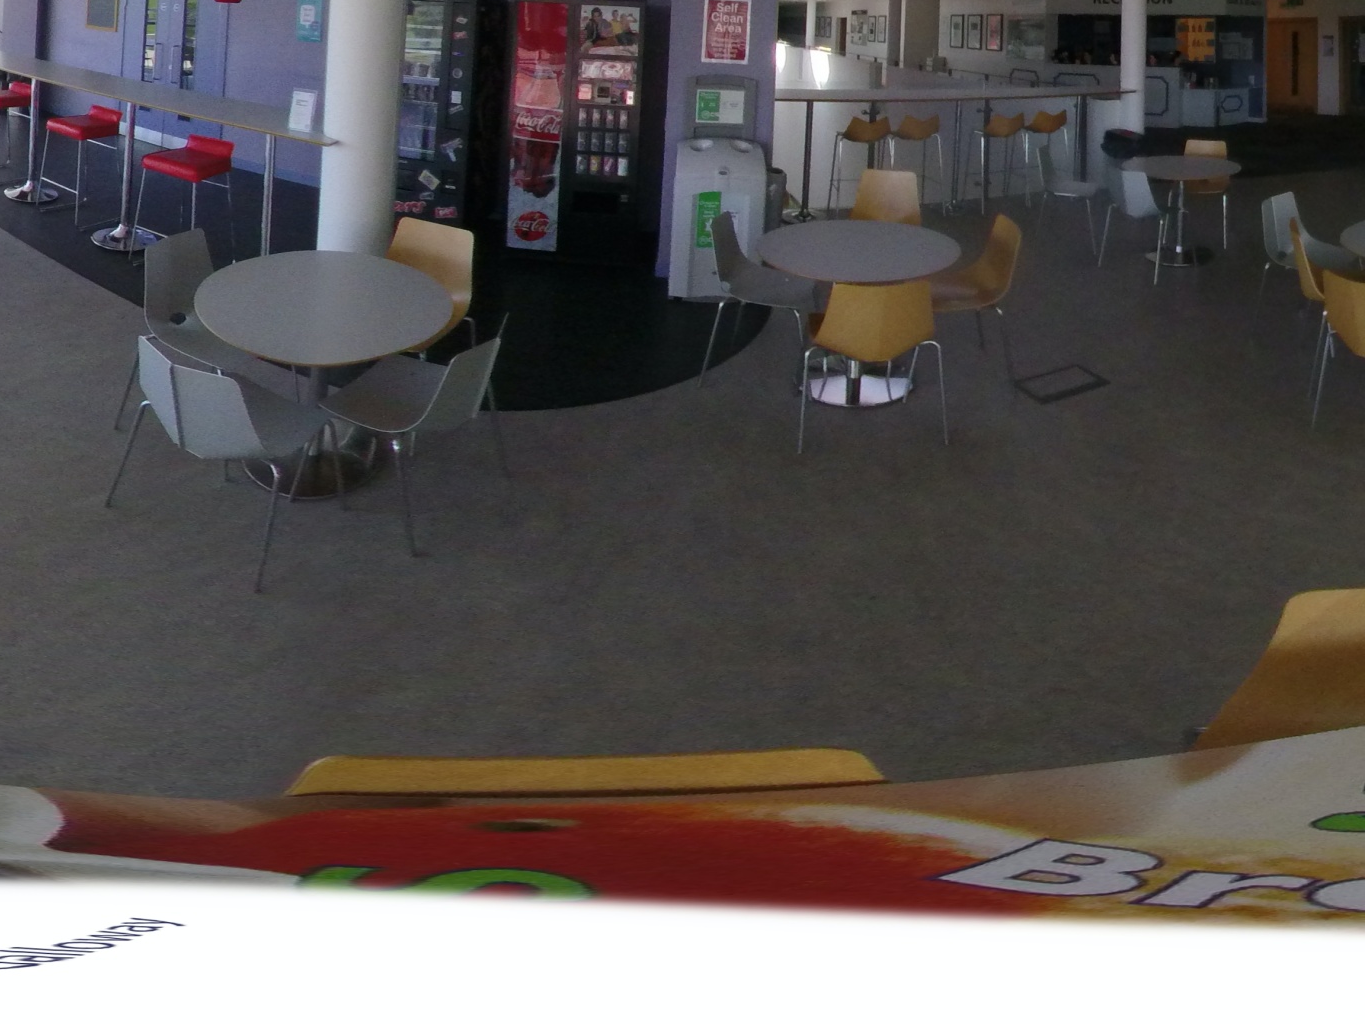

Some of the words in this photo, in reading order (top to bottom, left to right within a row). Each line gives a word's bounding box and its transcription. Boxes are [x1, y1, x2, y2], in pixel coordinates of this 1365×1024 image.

[716, 2, 739, 13] Self
[711, 12, 744, 24] Clean
[714, 22, 742, 33] Area
